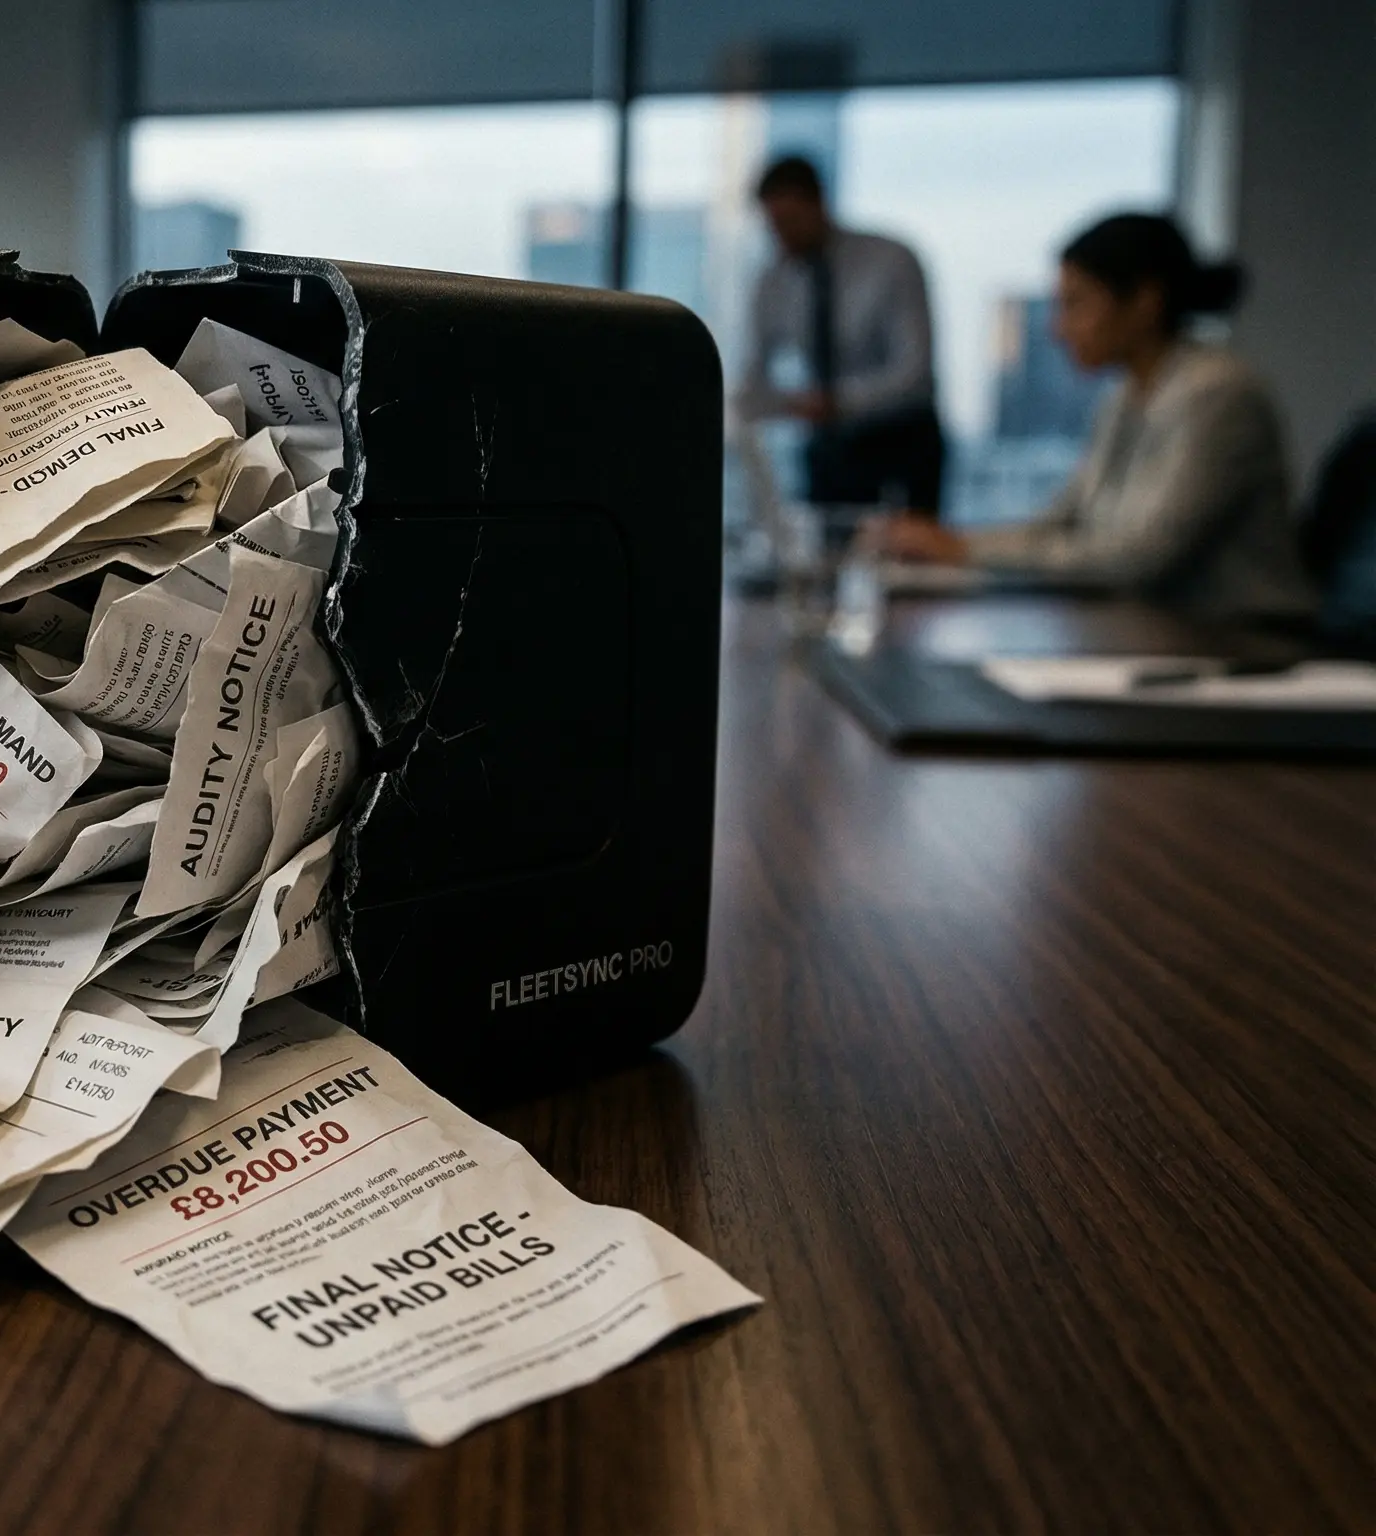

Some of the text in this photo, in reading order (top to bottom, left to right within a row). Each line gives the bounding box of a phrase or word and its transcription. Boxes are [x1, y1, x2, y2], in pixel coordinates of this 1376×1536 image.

[96, 417, 166, 445] FINAL
[180, 741, 233, 878] AUDITY
[216, 595, 276, 732] NOTICE
[490, 940, 673, 1011] FLEETSYNC PRO
[66, 1141, 230, 1230] OVERDUE
[230, 1064, 383, 1151] PAYMENT
[170, 1118, 352, 1222] £8,200.50
[251, 1271, 380, 1331] FINAL
[376, 1209, 516, 1281] NOTICE
[295, 1276, 448, 1353] UNPAID
[443, 1235, 556, 1304] BILLS
